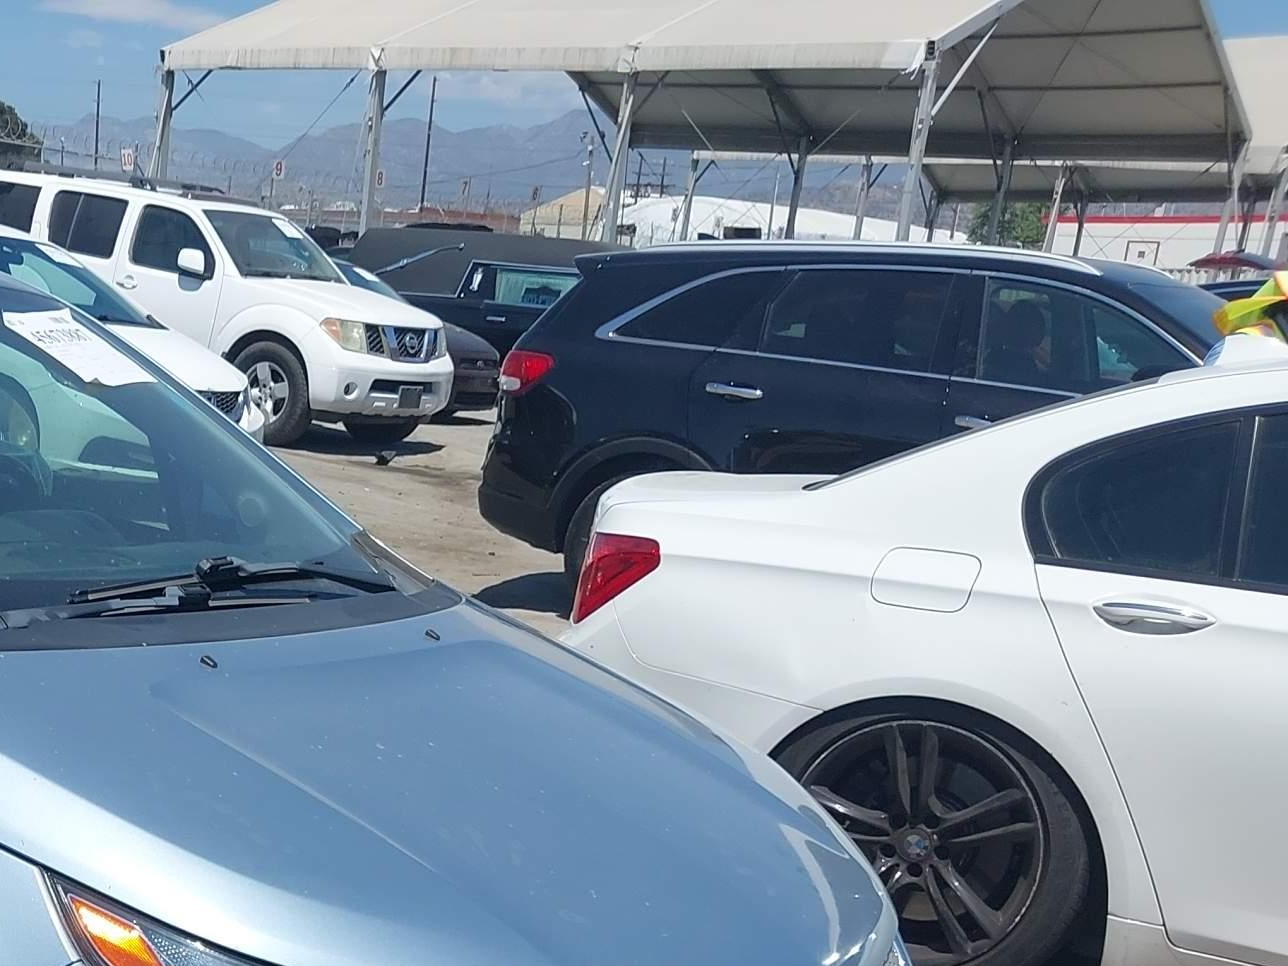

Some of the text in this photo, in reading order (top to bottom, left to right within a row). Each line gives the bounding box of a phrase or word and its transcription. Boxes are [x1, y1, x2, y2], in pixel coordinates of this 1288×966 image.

[122, 153, 133, 166] 10
[275, 161, 282, 176] 9
[377, 171, 383, 186] 8
